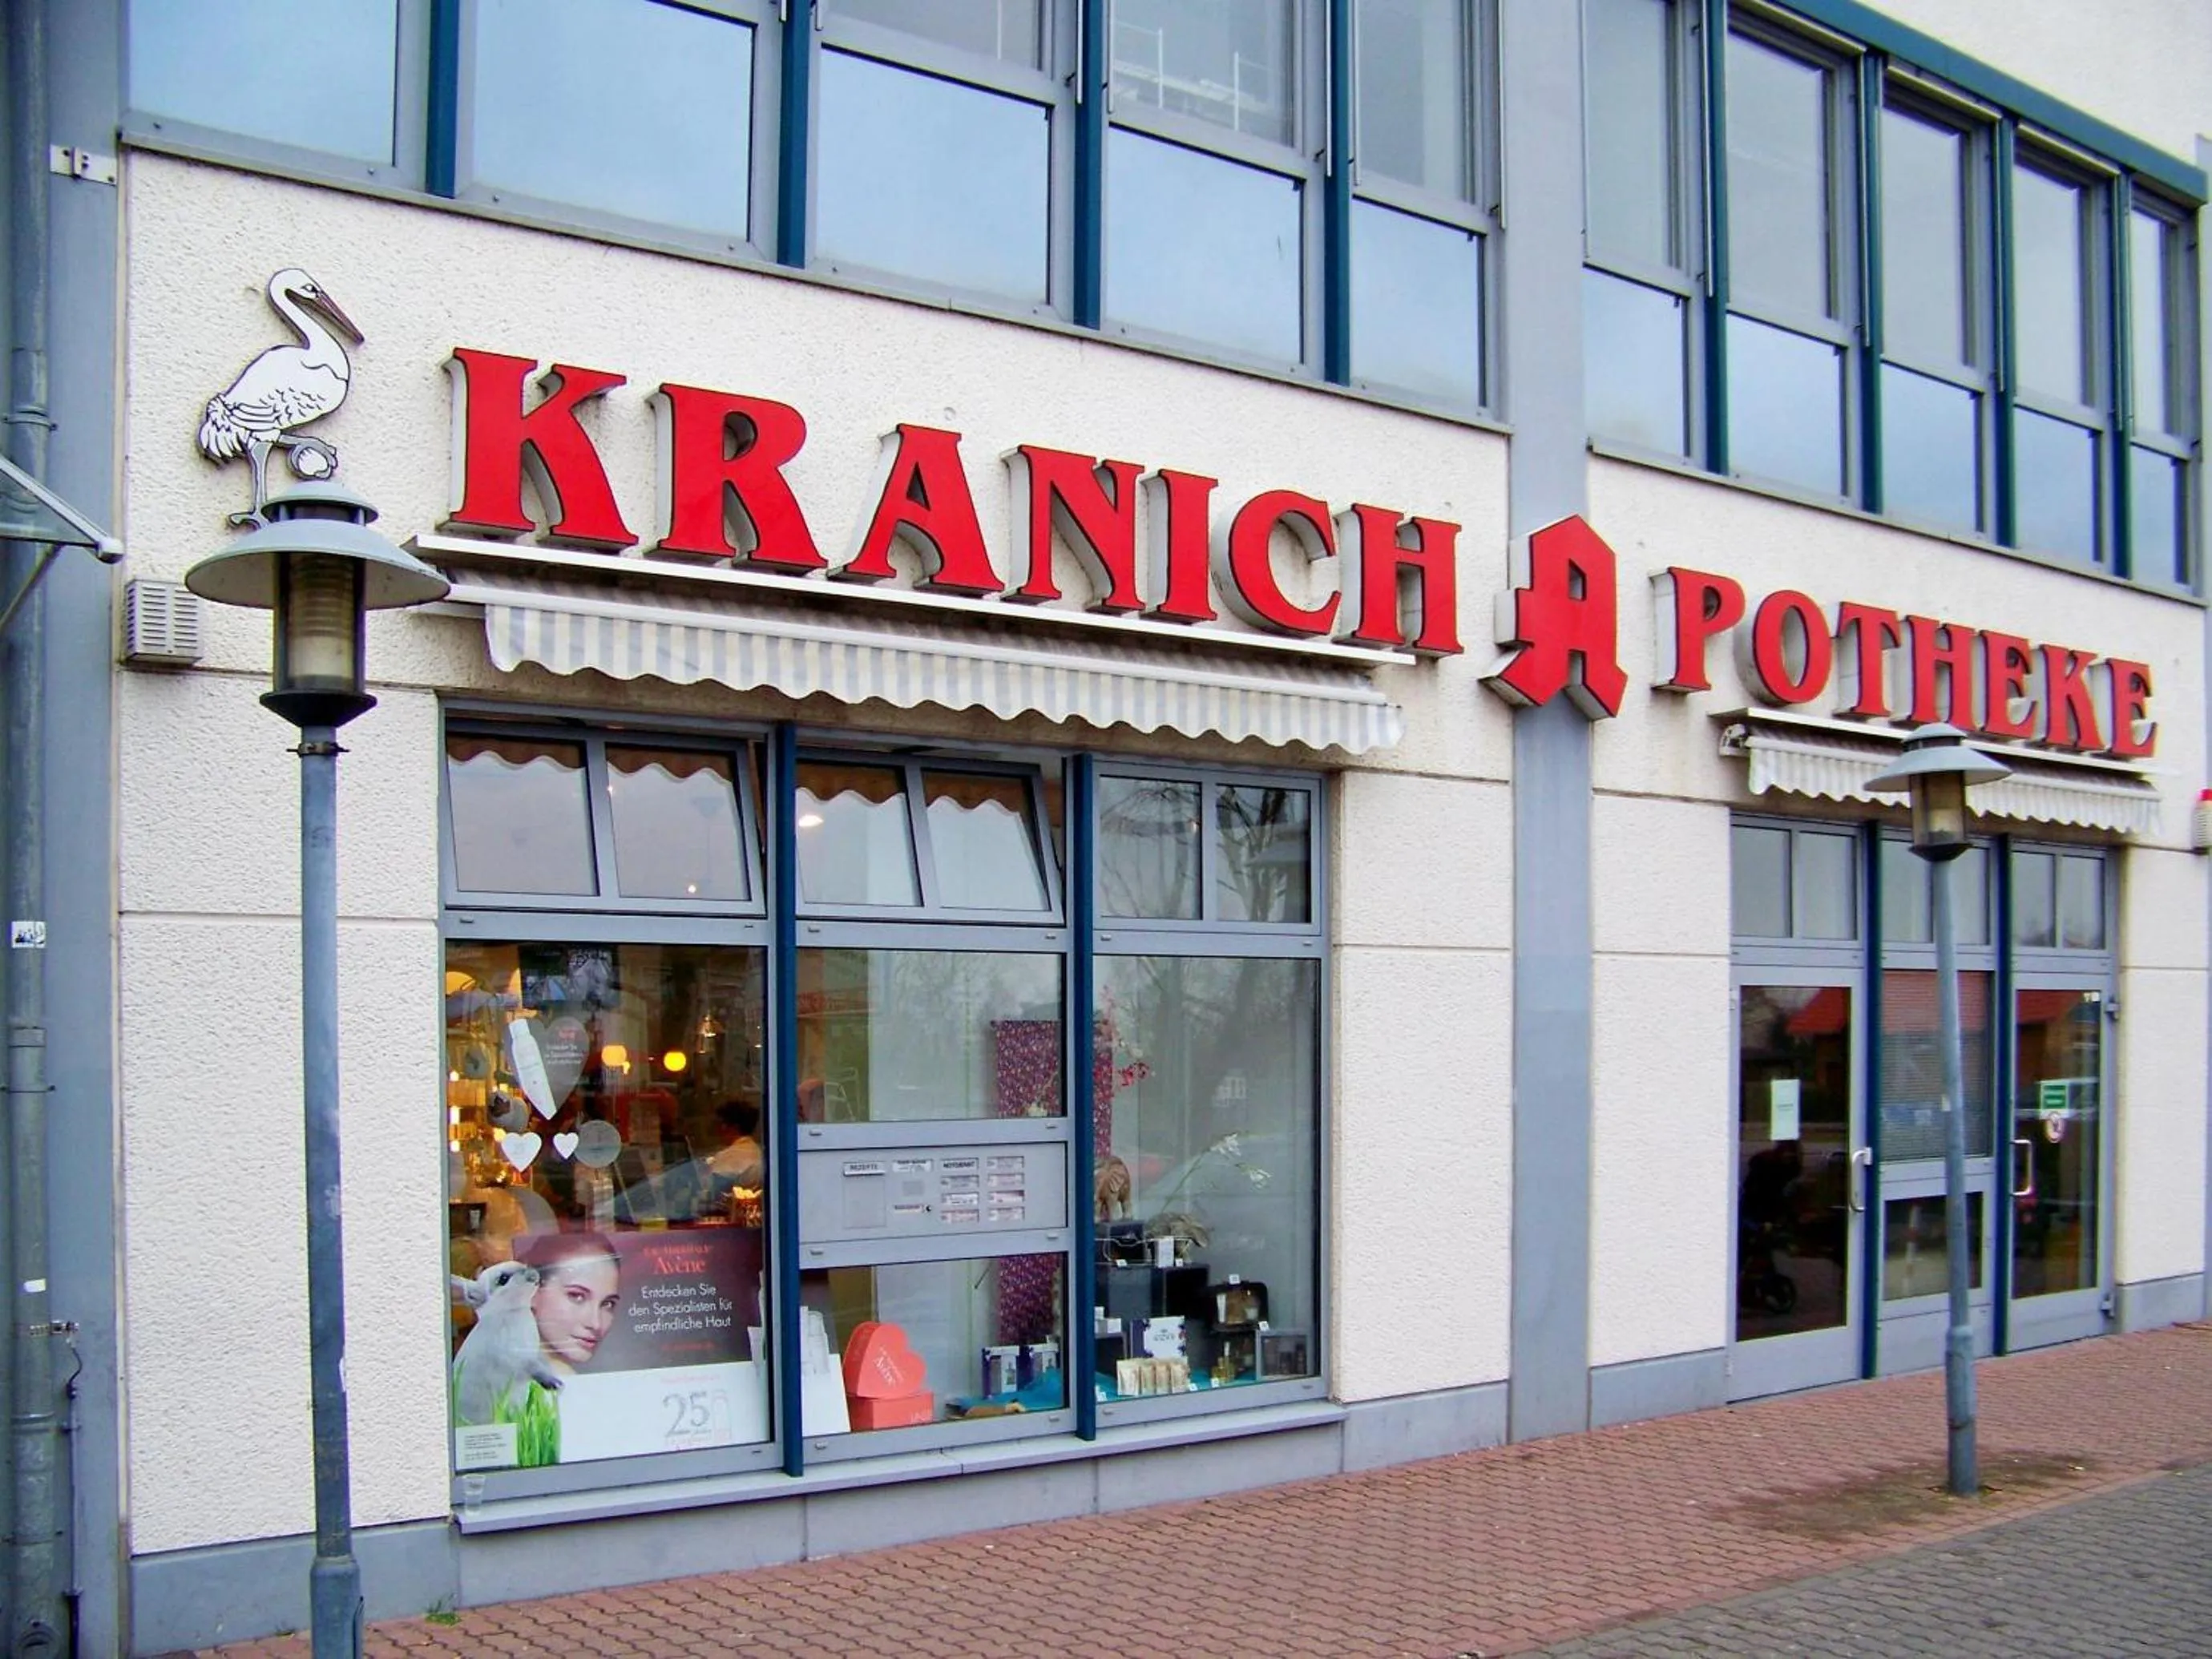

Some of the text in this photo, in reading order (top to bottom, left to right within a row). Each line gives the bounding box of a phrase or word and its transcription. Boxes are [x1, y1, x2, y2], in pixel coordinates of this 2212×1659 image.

[441, 346, 1464, 655] KRANICH
[641, 1282, 716, 1298] Entdecken Sie
[628, 1302, 650, 1316] den
[653, 1300, 716, 1317] Spezialisten
[634, 1315, 731, 1334] empfindliche Haut
[663, 1391, 710, 1438] 25
